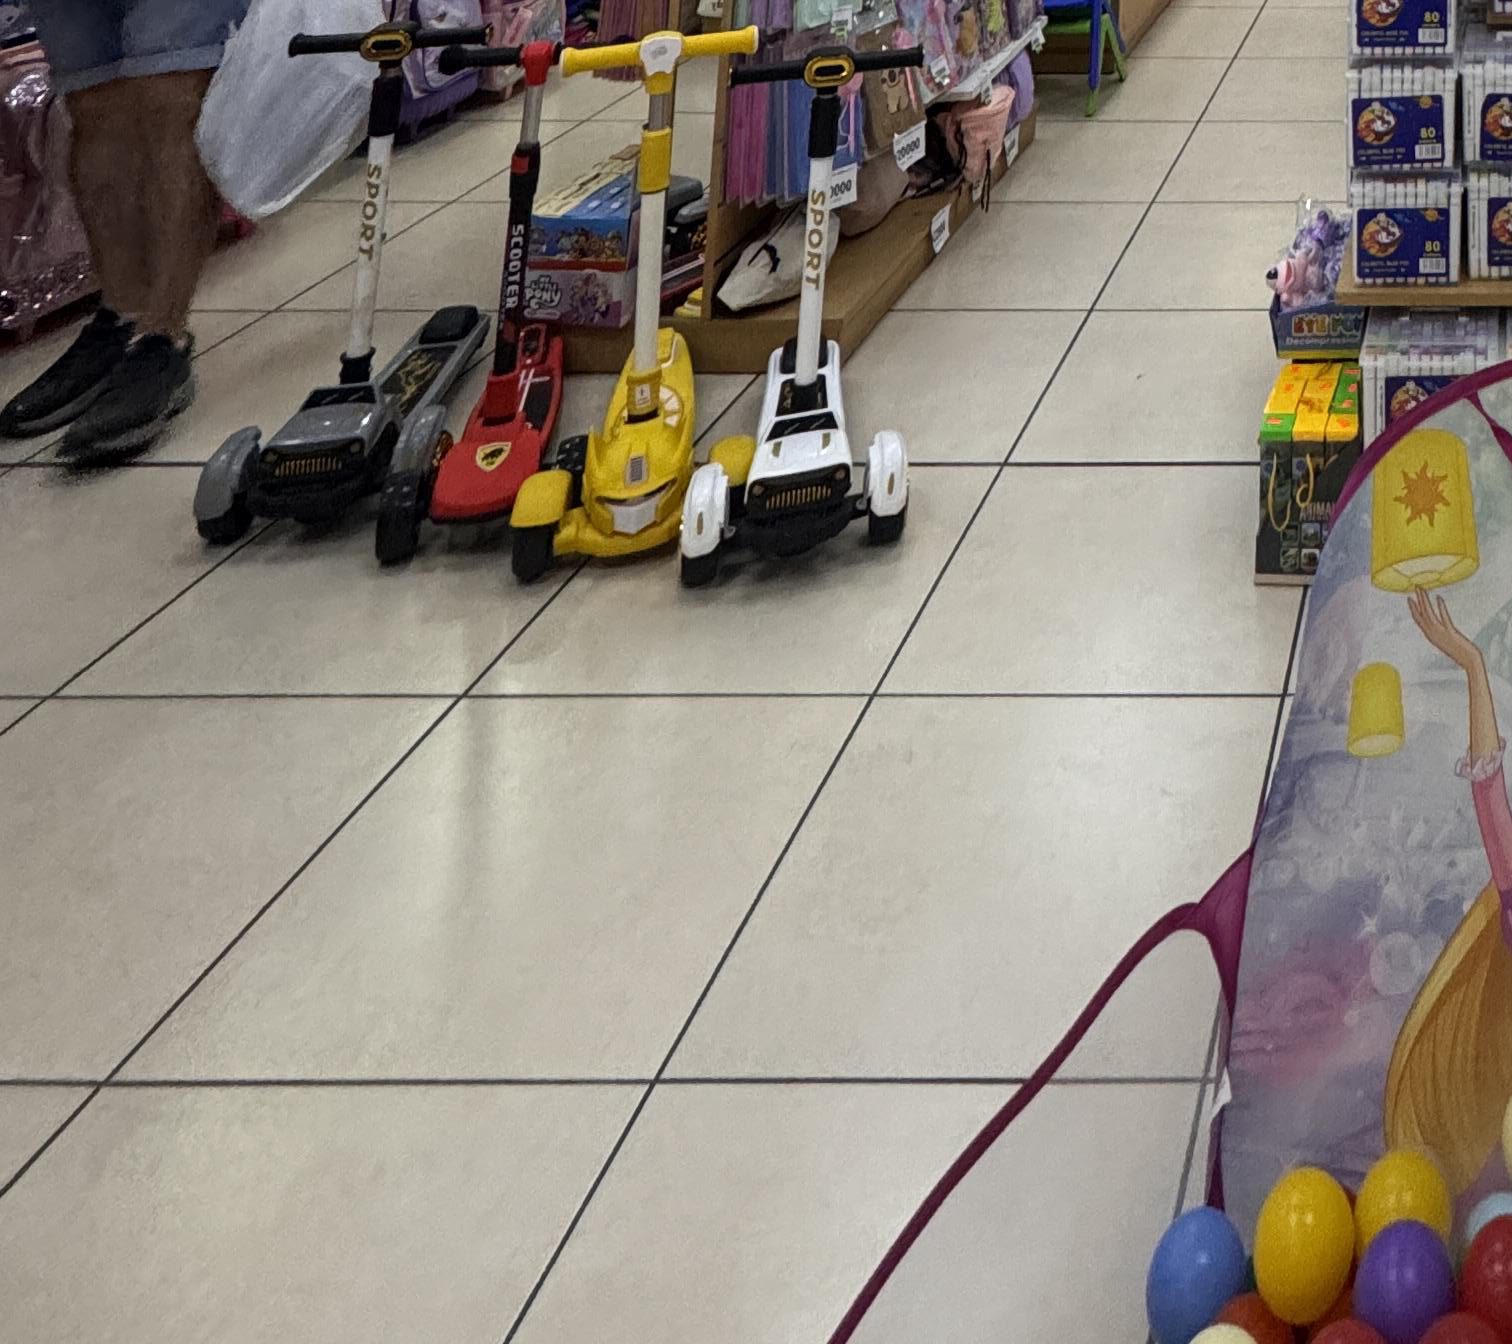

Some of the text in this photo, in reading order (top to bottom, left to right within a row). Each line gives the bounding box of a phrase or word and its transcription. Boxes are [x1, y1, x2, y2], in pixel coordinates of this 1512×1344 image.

[1424, 11, 1440, 22] 80
[1420, 127, 1436, 139] 80
[358, 163, 383, 261] SPORT
[803, 189, 826, 291] SPORT
[1425, 240, 1441, 252] 80
[503, 223, 525, 309] SCOOTER
